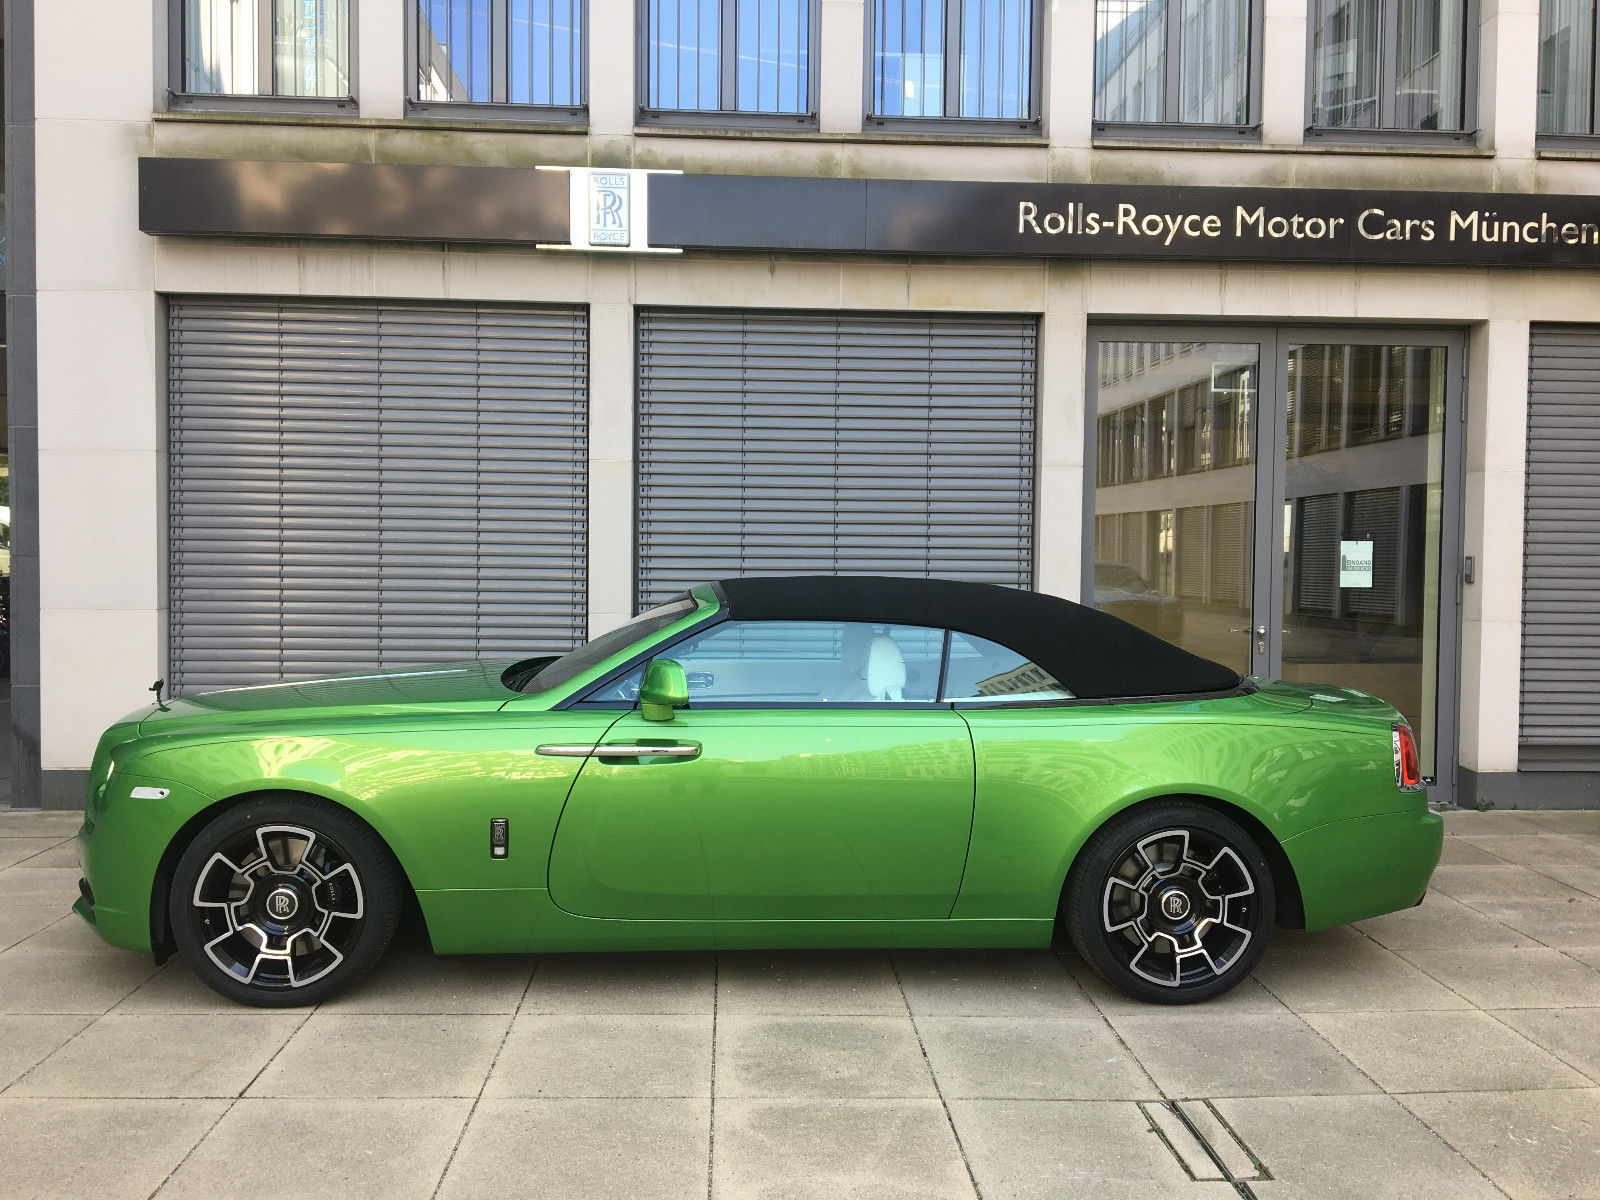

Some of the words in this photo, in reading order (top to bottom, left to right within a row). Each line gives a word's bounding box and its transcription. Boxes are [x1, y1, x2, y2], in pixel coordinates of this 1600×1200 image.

[593, 176, 625, 186] ROLLS
[1018, 201, 1221, 246] Rolls-Royce
[1235, 205, 1344, 240] Motor
[1357, 208, 1435, 242] Cars
[1449, 209, 1599, 245] München
[593, 232, 625, 241] ROYCE
[276, 895, 290, 914] RR
[1169, 896, 1183, 914] RR
